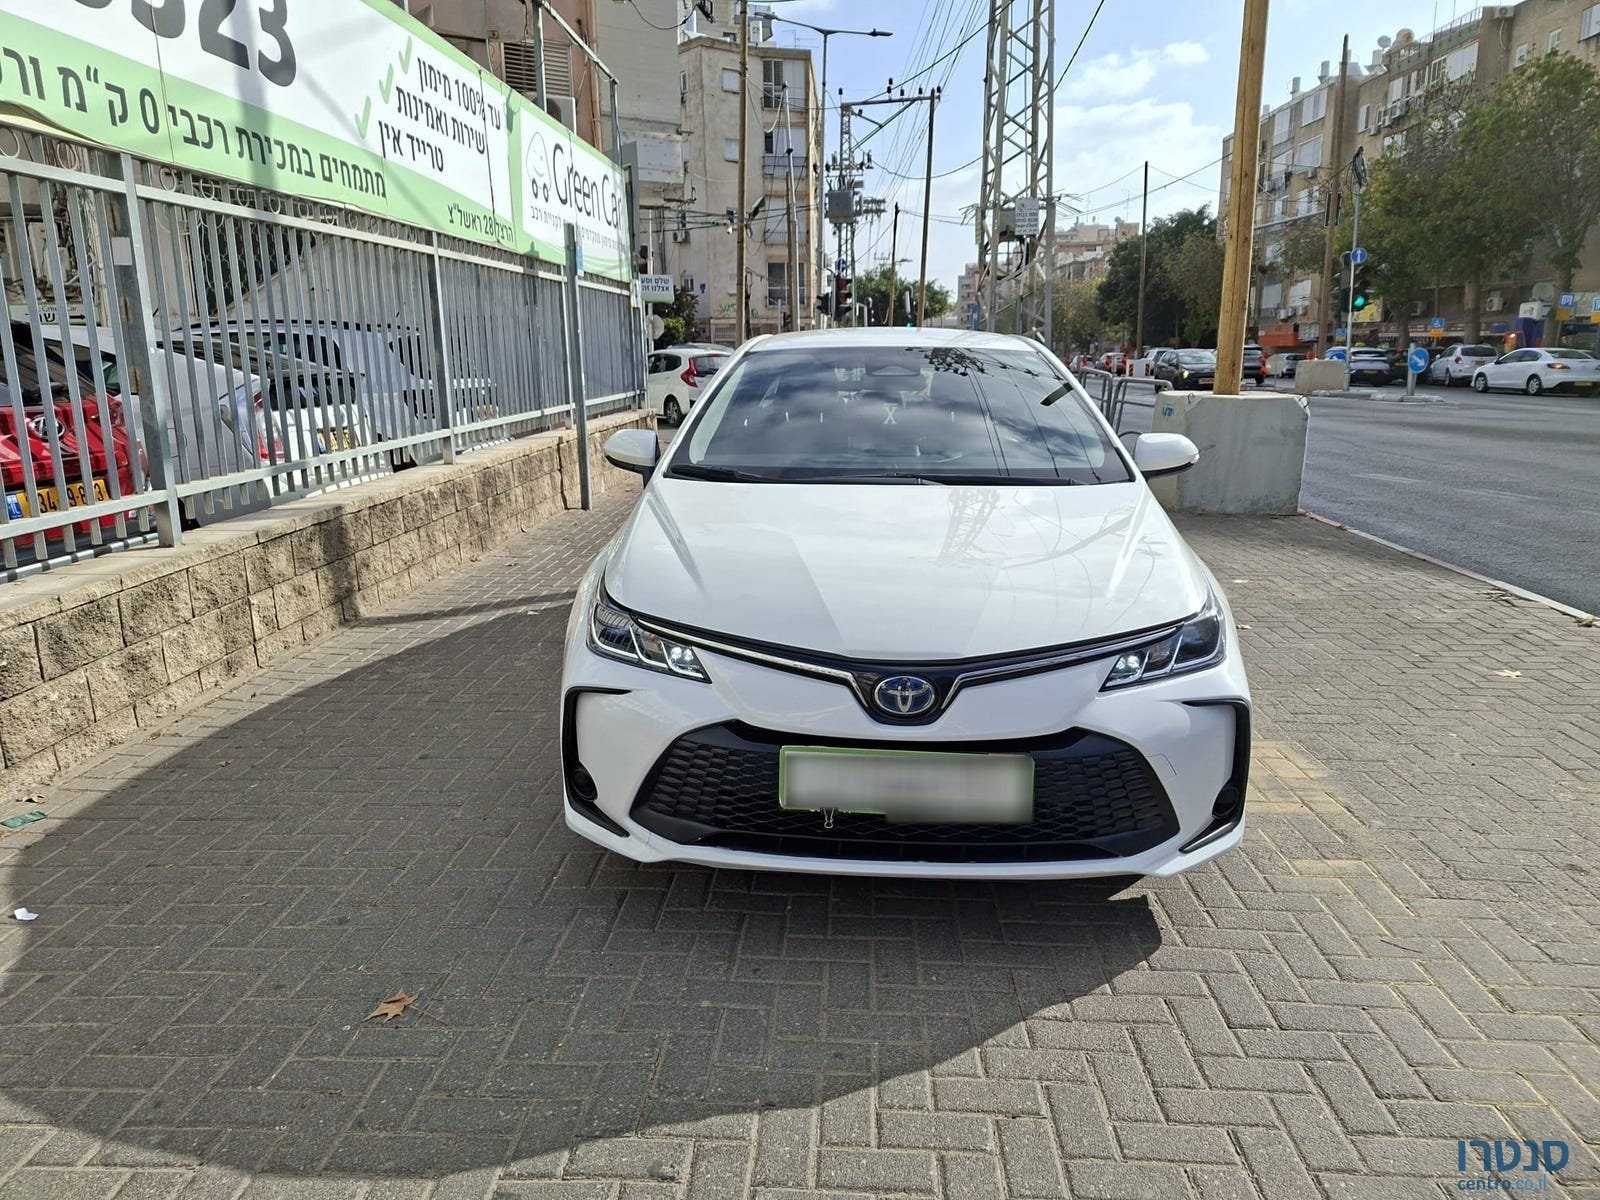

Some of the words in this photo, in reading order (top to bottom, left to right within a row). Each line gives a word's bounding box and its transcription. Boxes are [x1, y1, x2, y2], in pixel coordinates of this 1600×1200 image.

[0, 46, 46, 101] ור
[417, 57, 452, 101] מימון
[139, 87, 160, 134] 0
[395, 85, 449, 137] ואמינות
[455, 78, 485, 121] 100%
[488, 103, 501, 130] עד
[167, 104, 230, 155] רכבי
[235, 126, 316, 178] במכירת
[378, 119, 403, 158] אין
[406, 132, 444, 172] טרייד
[451, 116, 485, 155] שירות
[319, 152, 387, 199] מתמחים
[553, 142, 601, 222] Green
[602, 173, 622, 231] Car
[483, 214, 494, 236] 28
